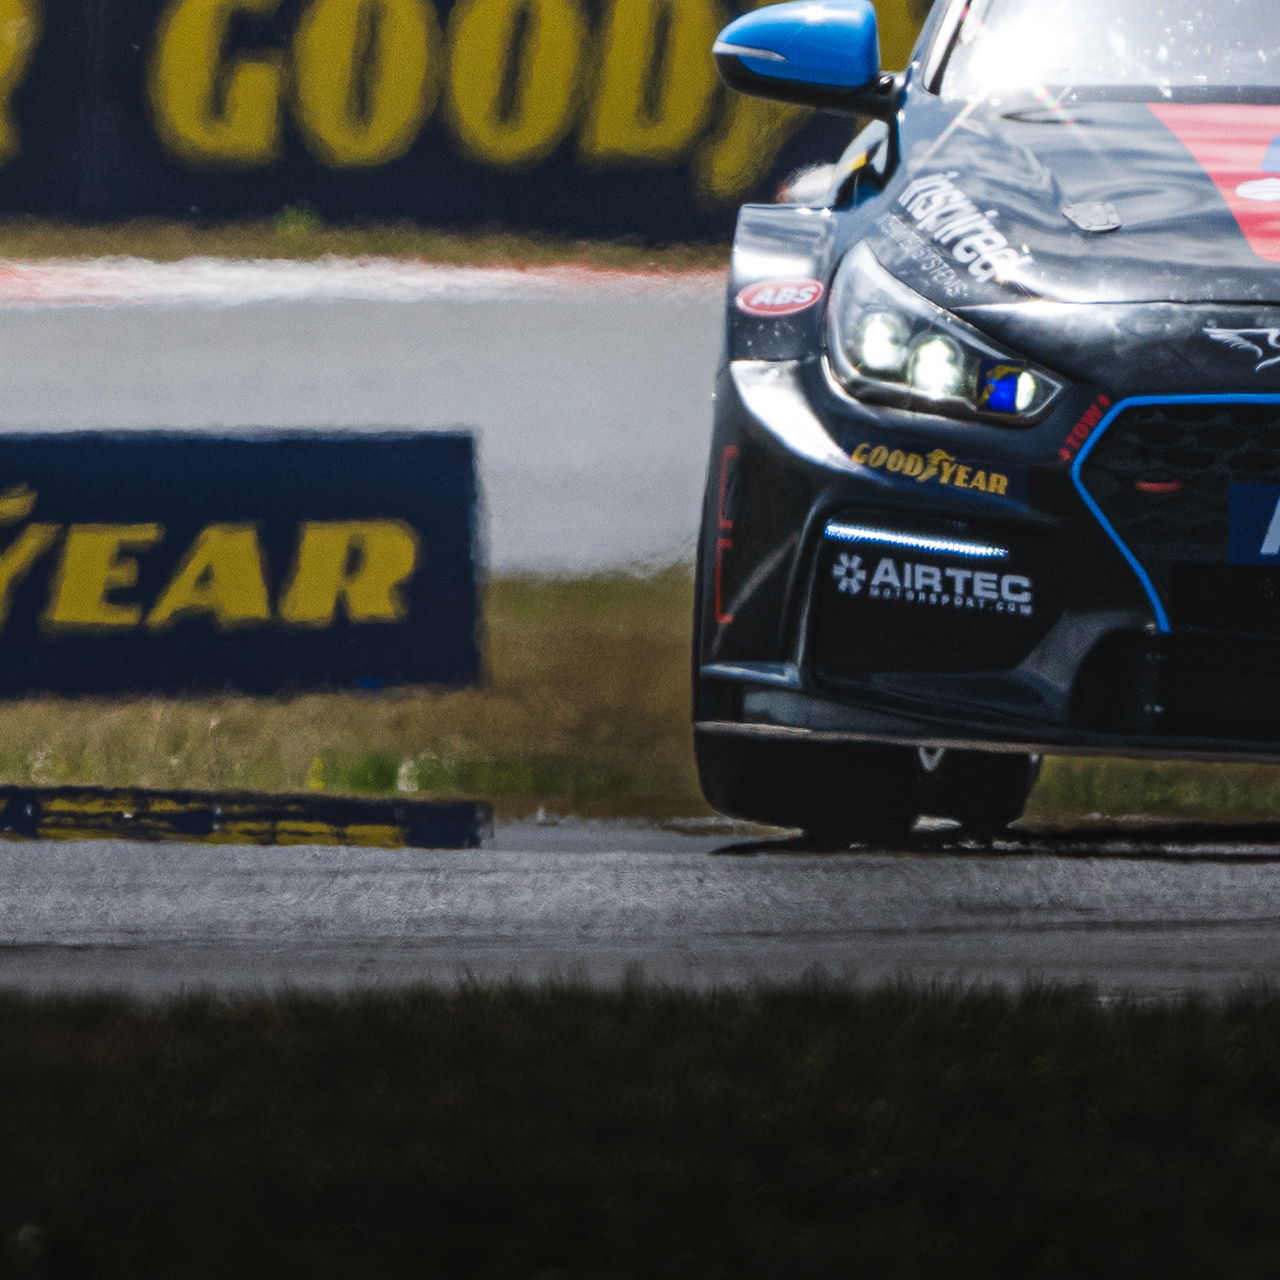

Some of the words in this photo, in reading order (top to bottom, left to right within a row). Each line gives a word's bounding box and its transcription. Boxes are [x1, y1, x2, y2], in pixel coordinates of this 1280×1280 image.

[749, 285, 819, 307] ABS
[851, 442, 1009, 496] GOODYEAR
[871, 558, 1032, 604] AIRTEC
